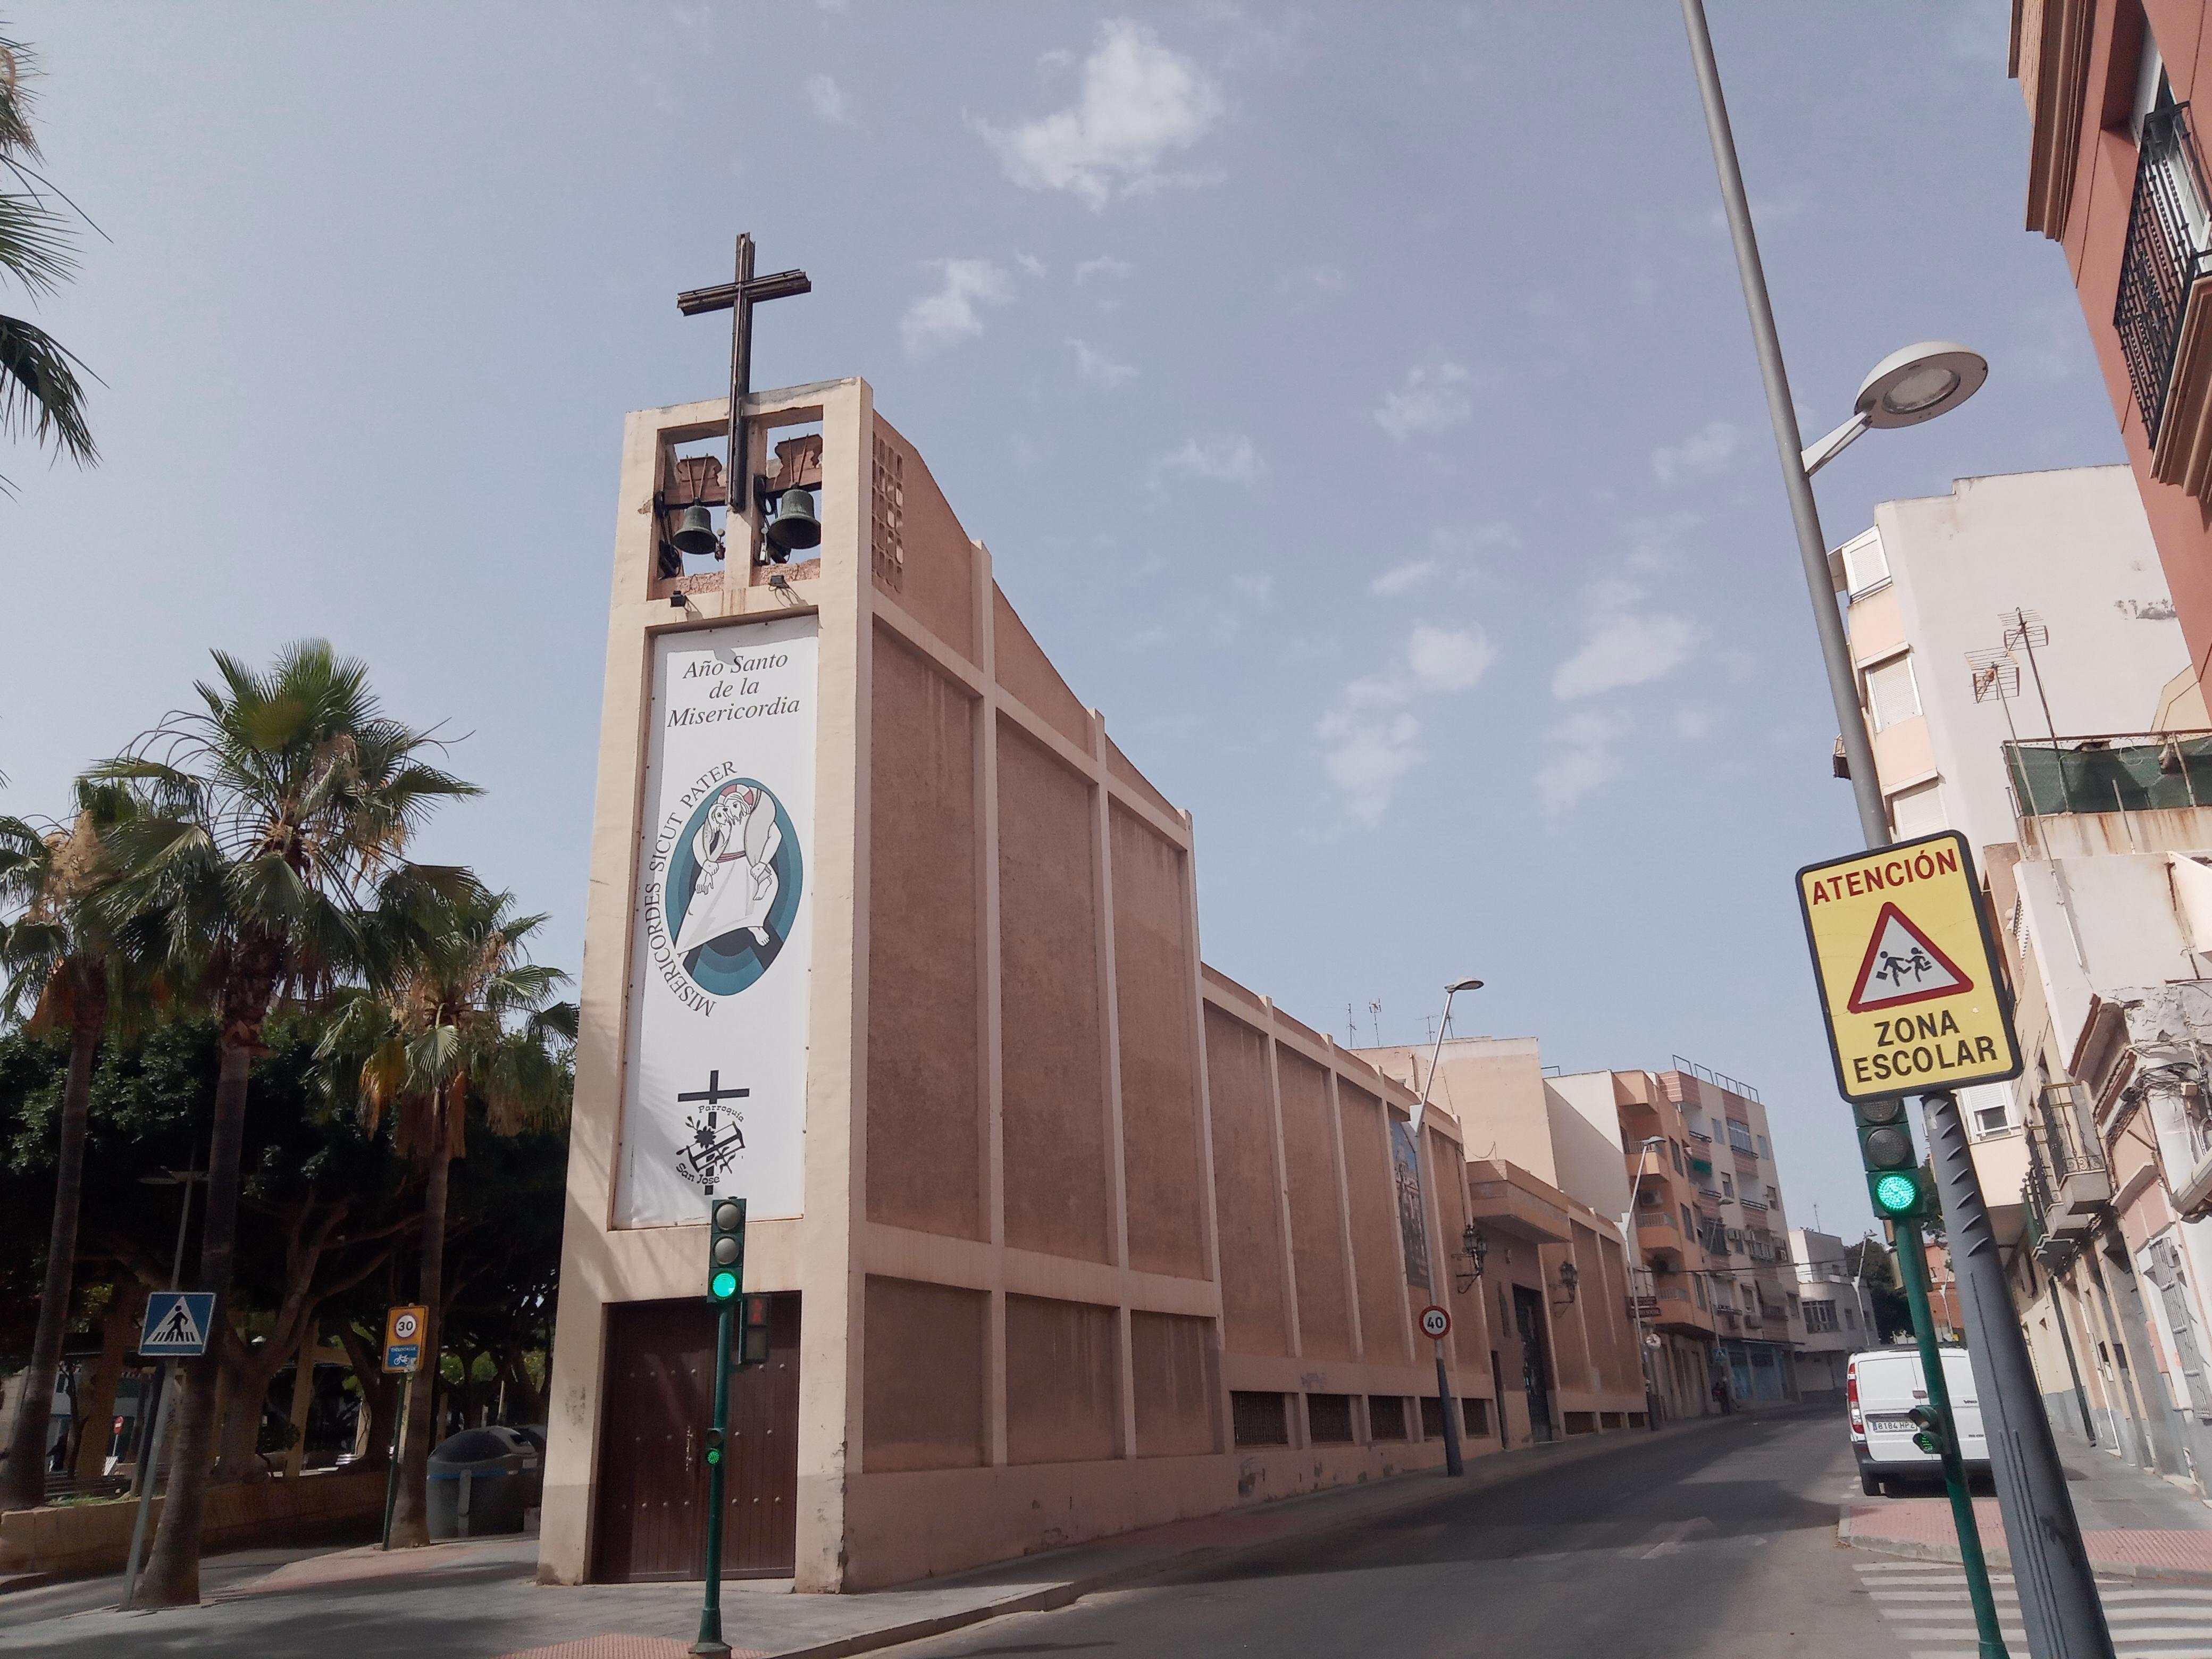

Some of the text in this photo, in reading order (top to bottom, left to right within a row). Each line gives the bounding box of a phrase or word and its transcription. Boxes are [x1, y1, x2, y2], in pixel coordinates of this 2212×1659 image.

[682, 654, 788, 679] Año Santo
[709, 677, 759, 699] de la
[667, 696, 800, 727] Misericordia
[644, 761, 738, 1018] MISERICORDES SICUT PATER
[1813, 849, 1958, 906] ATENCIÓN
[1874, 1010, 1960, 1048] ZONA
[1853, 1035, 1998, 1084] ESCOLAR
[676, 1162, 720, 1184] San José
[398, 1321, 413, 1331] 30
[1427, 1317, 1443, 1329] 40
